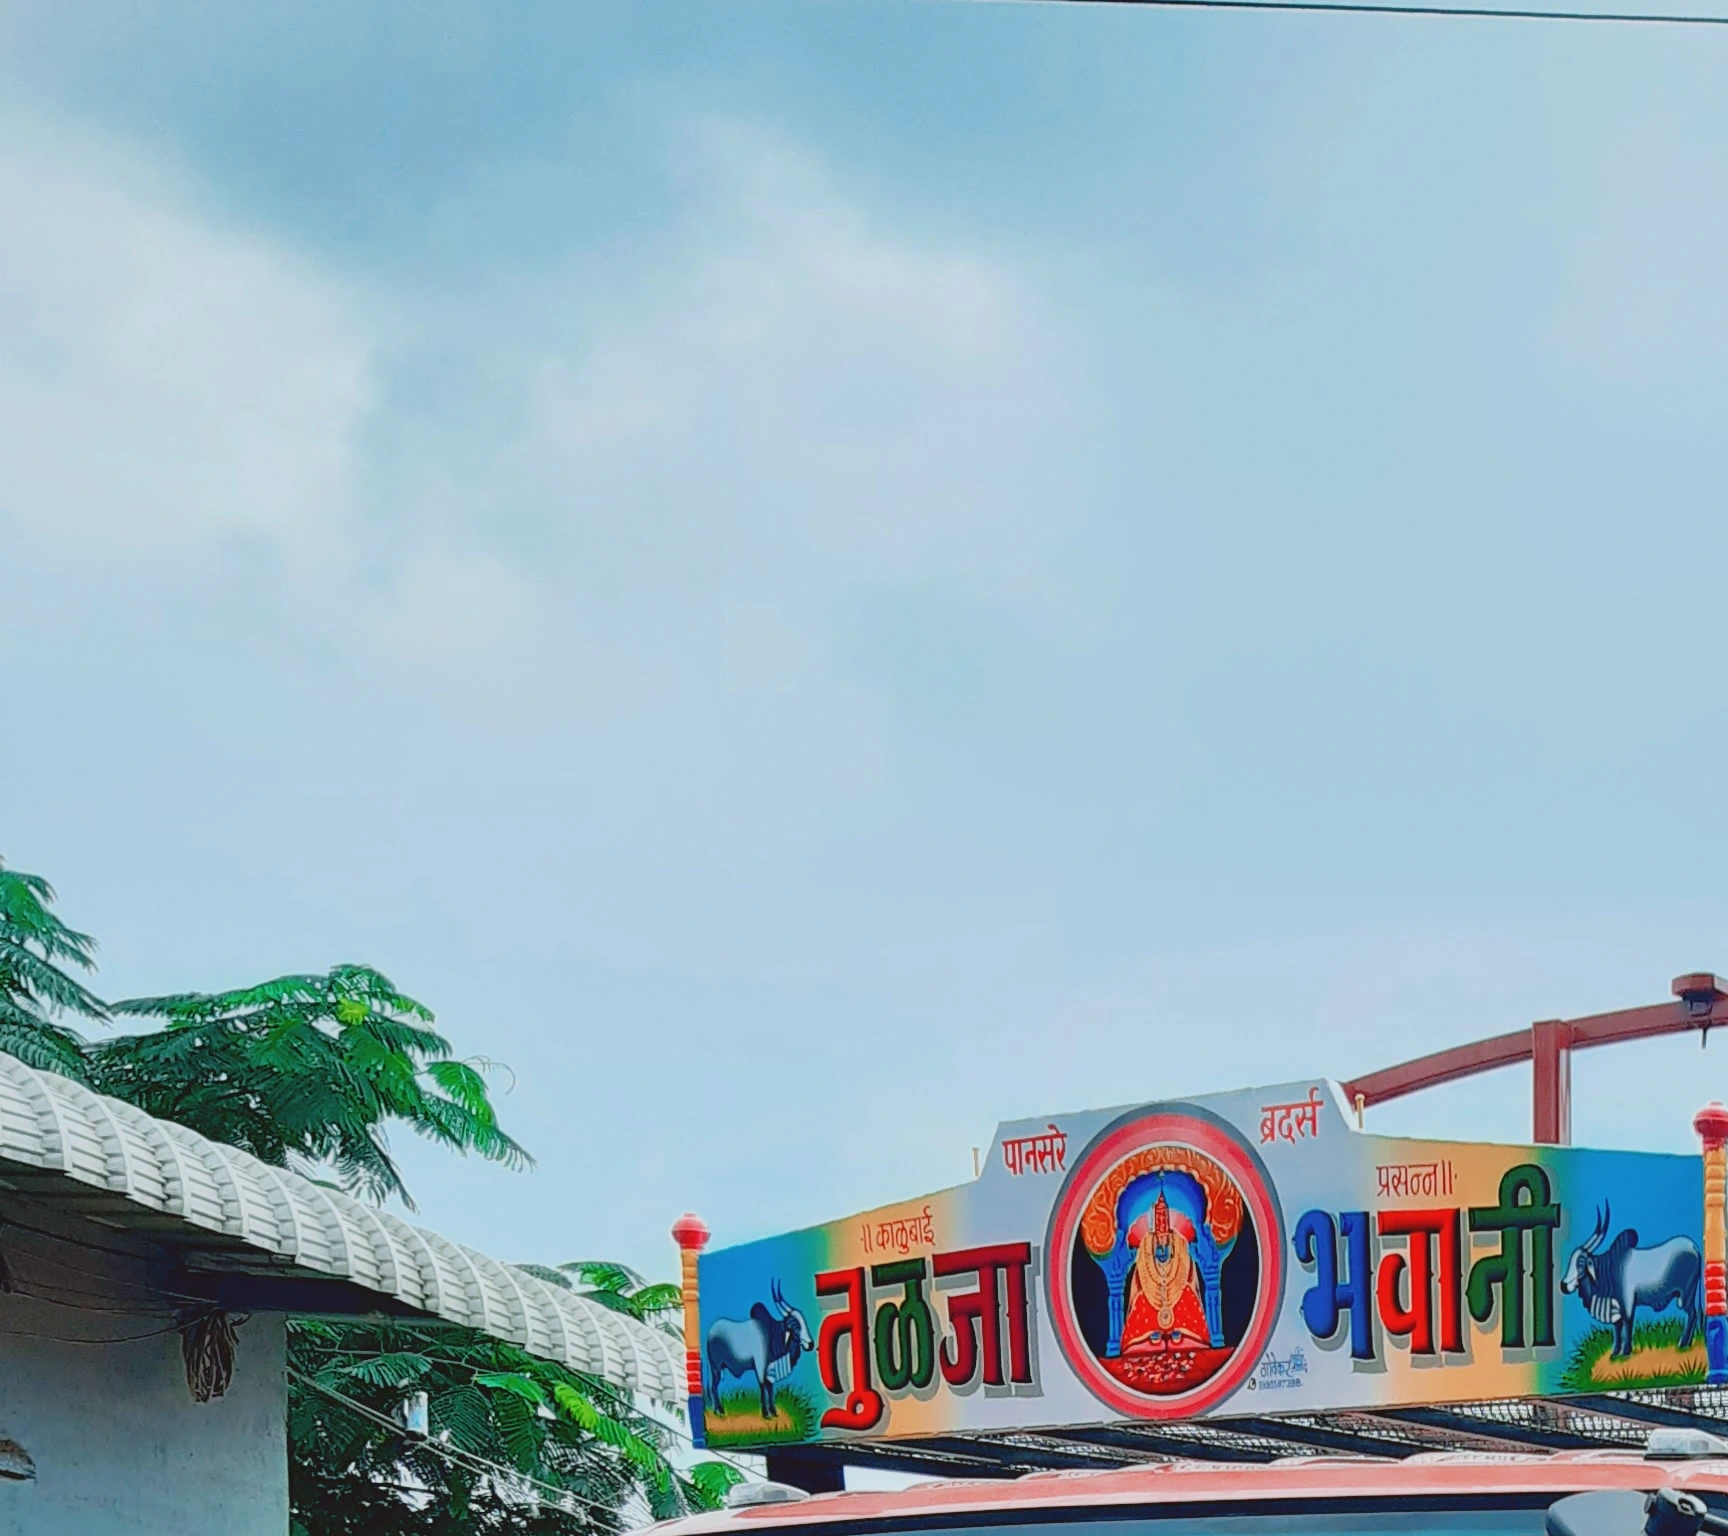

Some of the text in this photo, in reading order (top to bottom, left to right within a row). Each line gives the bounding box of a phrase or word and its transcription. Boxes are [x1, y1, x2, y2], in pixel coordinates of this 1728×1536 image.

[1001, 1124, 1067, 1175] पानसरे
[1258, 1087, 1324, 1144] ब्रदर्स
[1292, 1163, 1561, 1360] भवानी
[814, 1241, 1033, 1430] तुळजा
